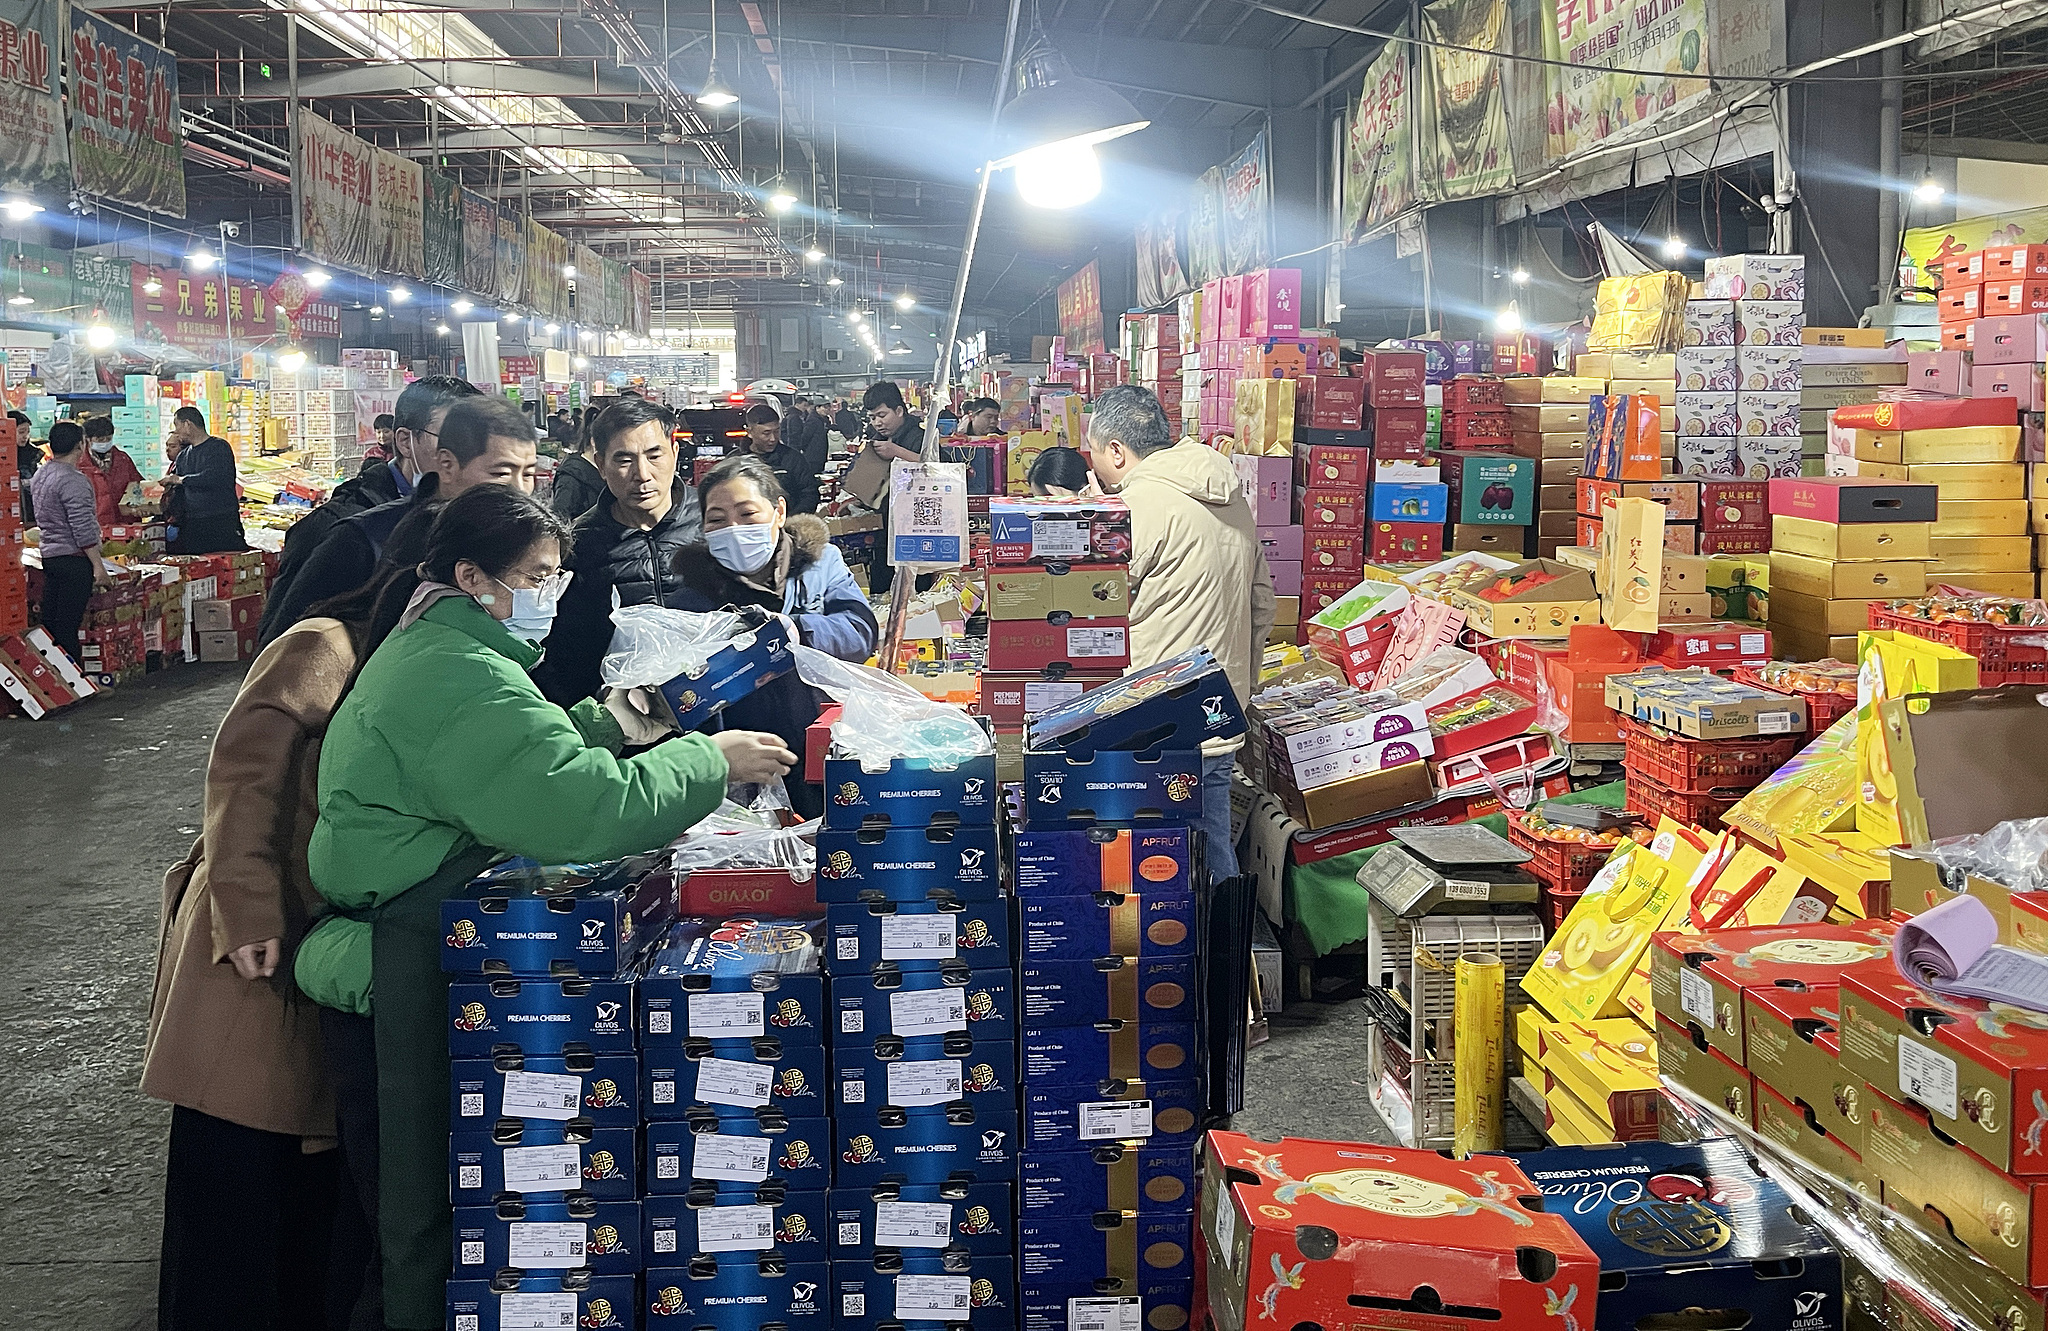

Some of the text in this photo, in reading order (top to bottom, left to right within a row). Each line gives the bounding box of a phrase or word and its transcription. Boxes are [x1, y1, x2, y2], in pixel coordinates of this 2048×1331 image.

[1628, 536, 1648, 574] 红美人
[1669, 598, 1679, 617] 红美
[1086, 782, 1147, 790] PREMIUM CHERRIES
[911, 789, 941, 797] CHERRIES
[1142, 837, 1181, 847] APFRUT
[873, 861, 936, 870] PREMIUM CHERRIES
[709, 890, 773, 902] JOYVIO
[1150, 901, 1189, 911] APFRUT
[496, 932, 558, 940] PREMIUM CHERRIES
[580, 939, 603, 947] OLIVOS
[539, 1014, 571, 1022] CHERRIES
[594, 1021, 618, 1029] OLIVOS
[1156, 1089, 1191, 1098] APFRU
[926, 1144, 957, 1152] CHERRIES
[980, 1149, 1003, 1157] OLIVOS
[1149, 1158, 1187, 1167] APFRUT
[1534, 1165, 1651, 1180] PREMIUM CHERRIES
[1536, 1179, 1643, 1214] Olivos
[1148, 1224, 1186, 1233] APFRUT
[704, 1296, 768, 1305] PREMIUM CHERRIES
[1792, 1317, 1824, 1329] OLIVOS
